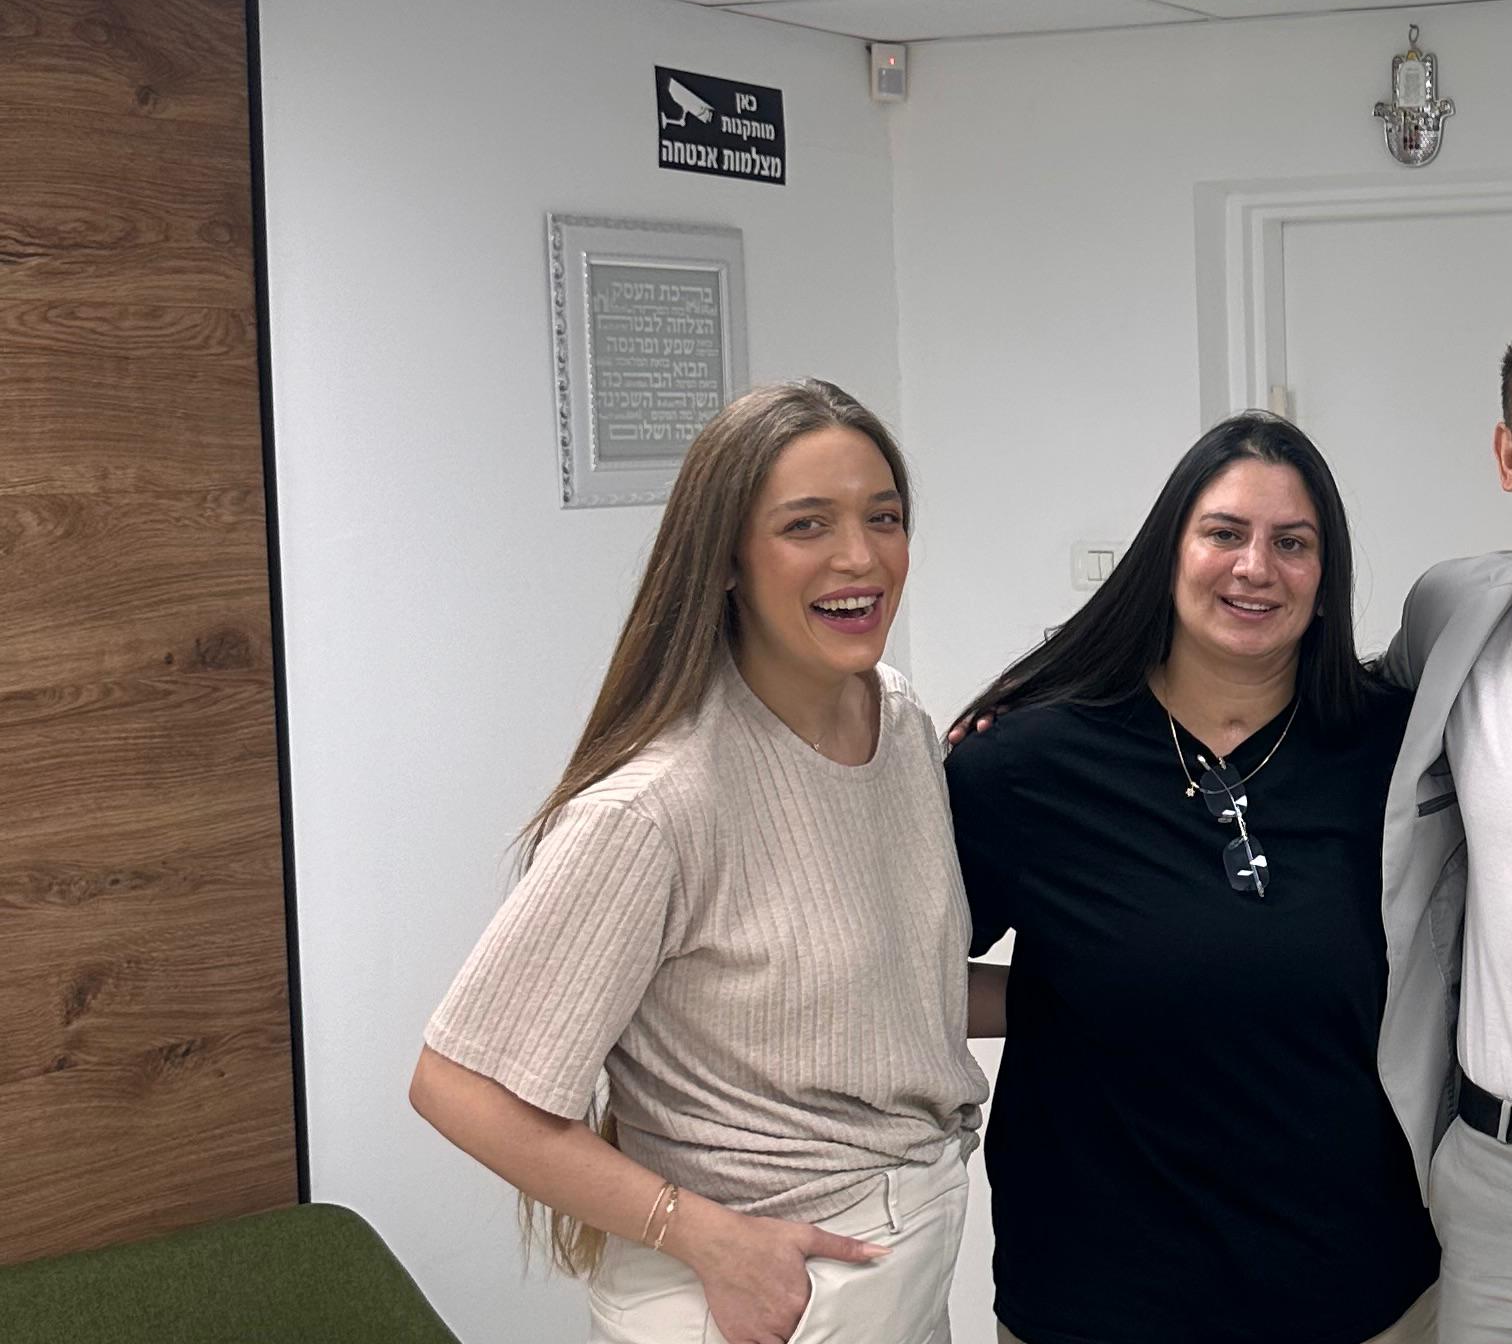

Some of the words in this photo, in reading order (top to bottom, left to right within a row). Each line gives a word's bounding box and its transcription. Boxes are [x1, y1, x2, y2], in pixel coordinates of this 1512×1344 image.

[735, 92, 758, 114] כאן
[721, 116, 775, 141] מותקנות
[661, 139, 718, 169] אבטחה
[723, 147, 782, 178] מצלמות
[667, 314, 715, 335] הצלחה
